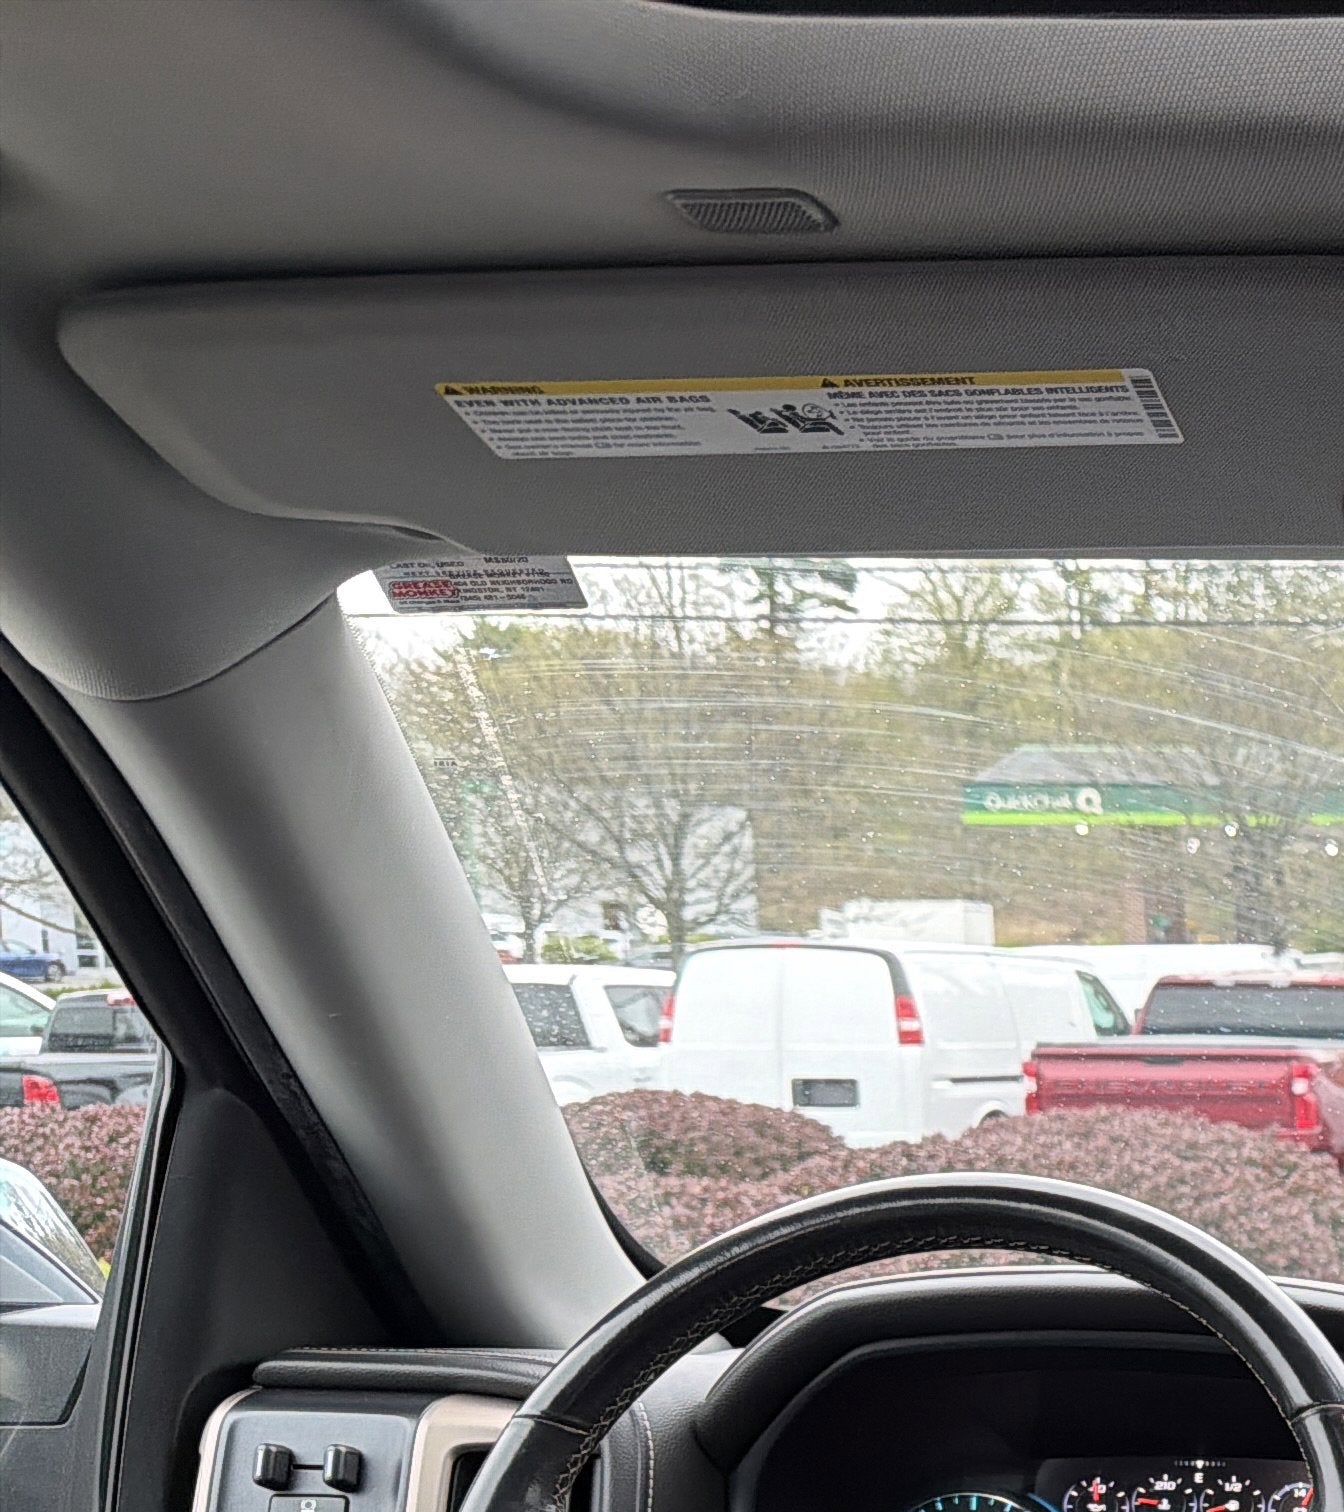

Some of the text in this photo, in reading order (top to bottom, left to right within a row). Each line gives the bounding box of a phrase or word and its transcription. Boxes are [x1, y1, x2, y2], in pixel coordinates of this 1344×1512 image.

[844, 377, 976, 387] AVERTISSEMENT
[869, 390, 899, 399] AVEC
[902, 390, 927, 398] DES
[928, 389, 962, 398] SACS
[965, 386, 1043, 397] GONFLABLES
[1045, 385, 1129, 395] INTELLIGENTS
[456, 395, 711, 408] EVEN WITH ADVANCED AIR BAGS
